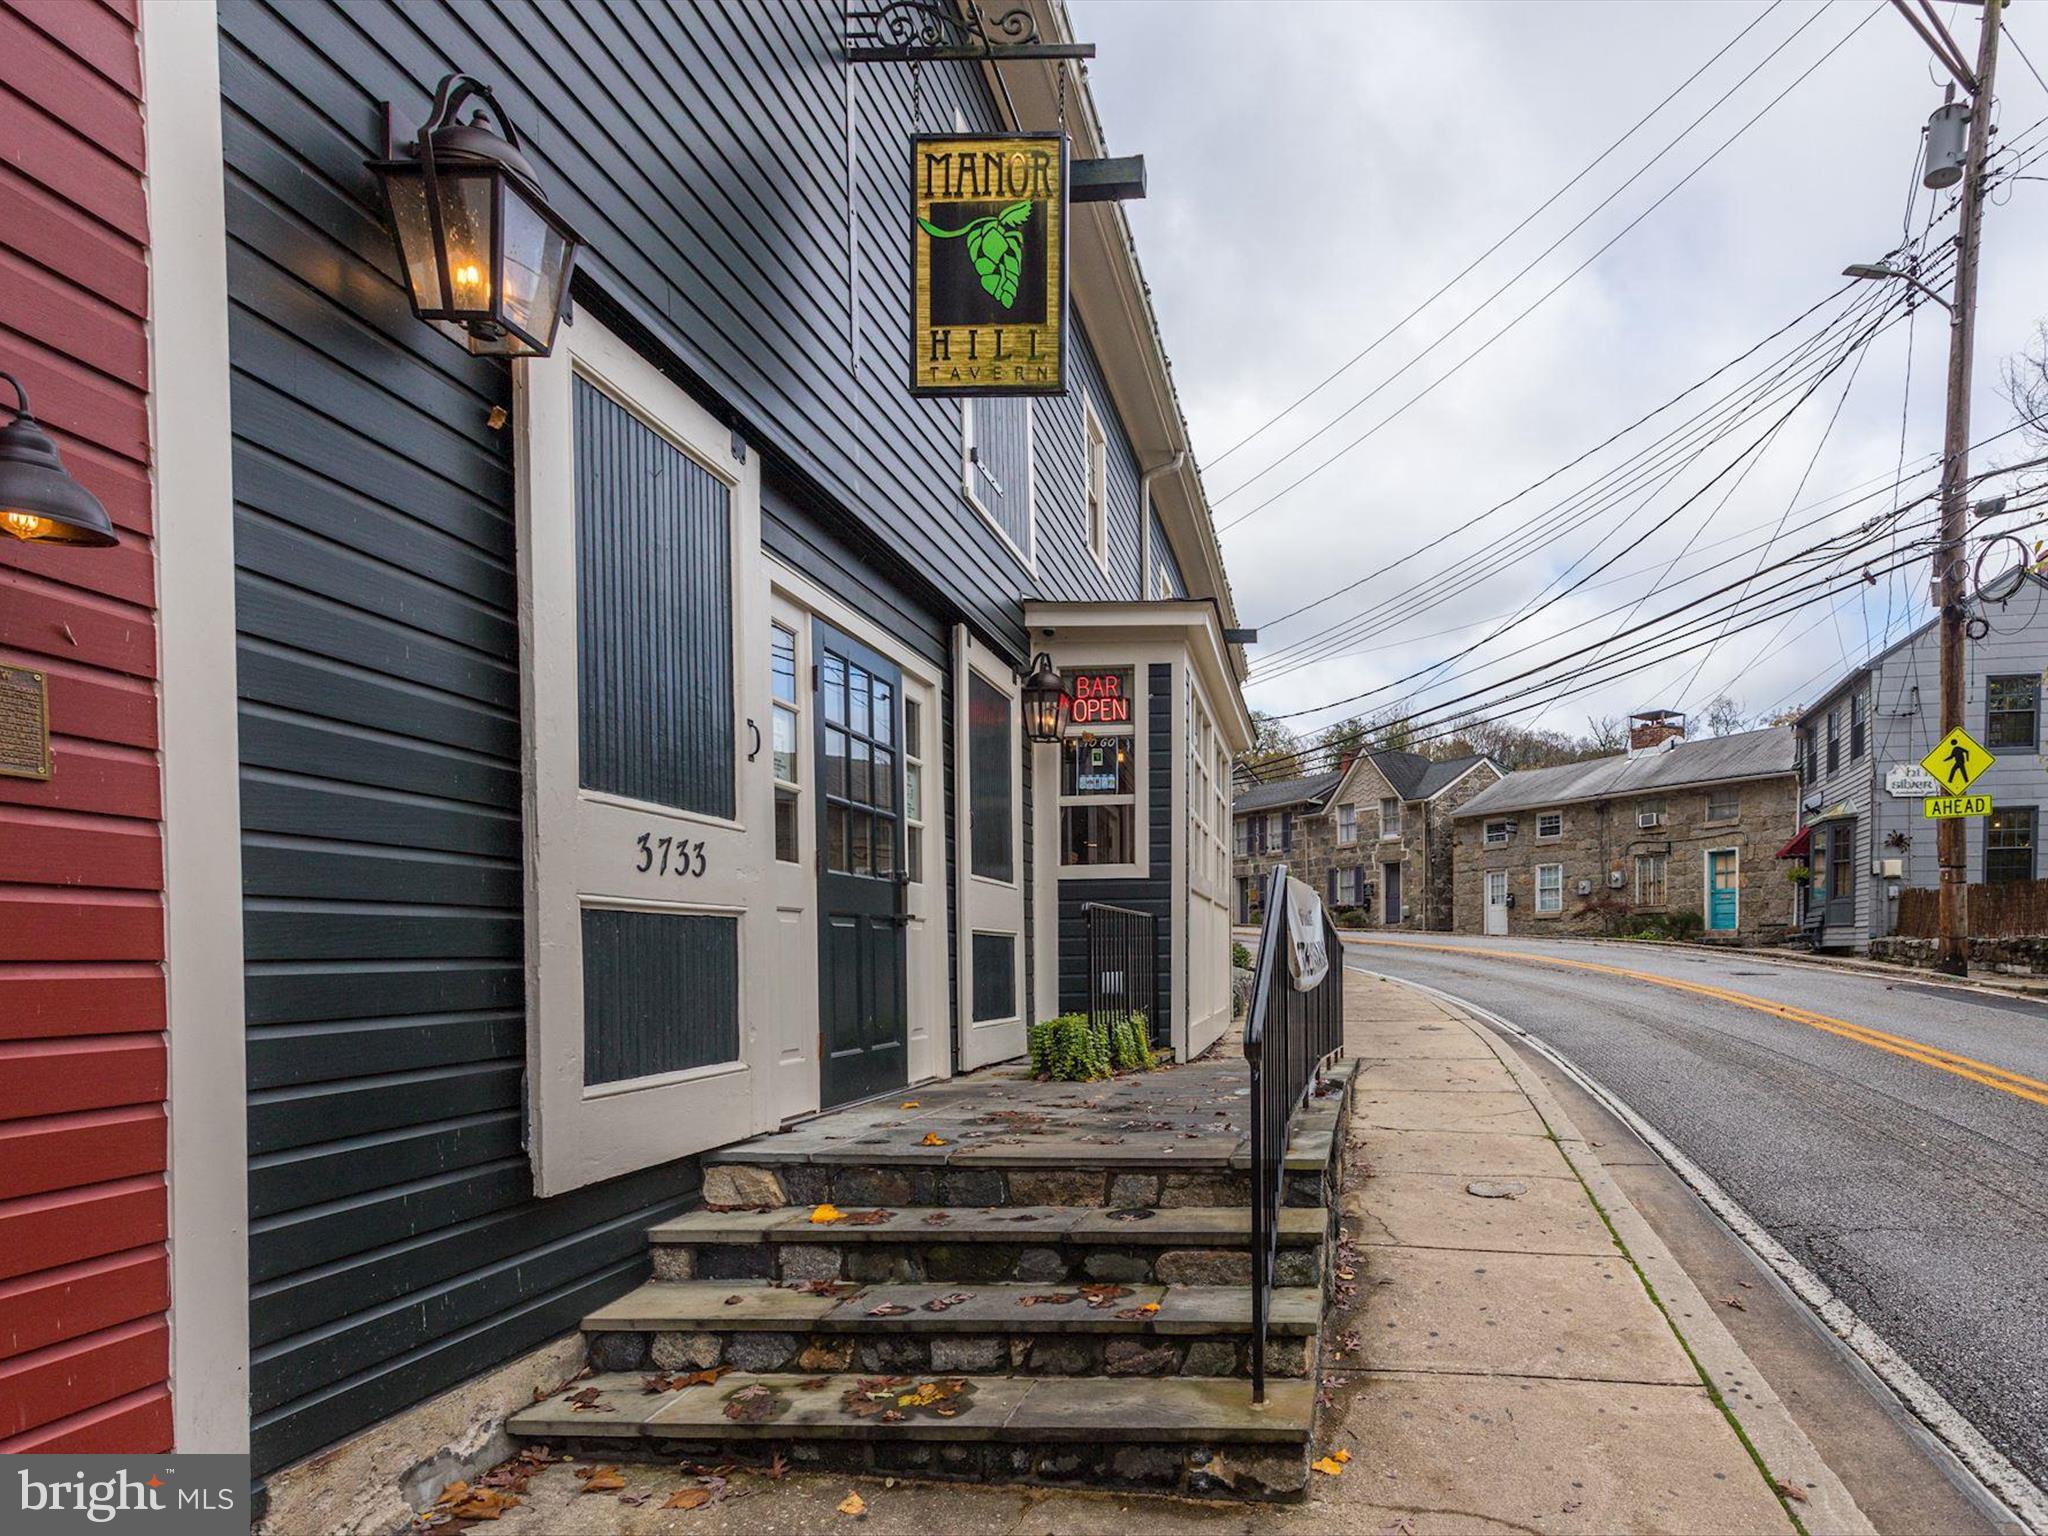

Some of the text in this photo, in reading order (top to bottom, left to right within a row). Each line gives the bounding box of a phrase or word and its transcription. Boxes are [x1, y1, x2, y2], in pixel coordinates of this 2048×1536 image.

[925, 151, 1053, 198] MANOR
[930, 329, 1046, 361] HILL
[930, 366, 1049, 381] TAVERN
[1076, 675, 1119, 699] BAR
[1073, 698, 1127, 723] OPEN
[1100, 738, 1116, 748] GO
[1932, 798, 1985, 815] AHEAD
[636, 832, 707, 878] 3733
